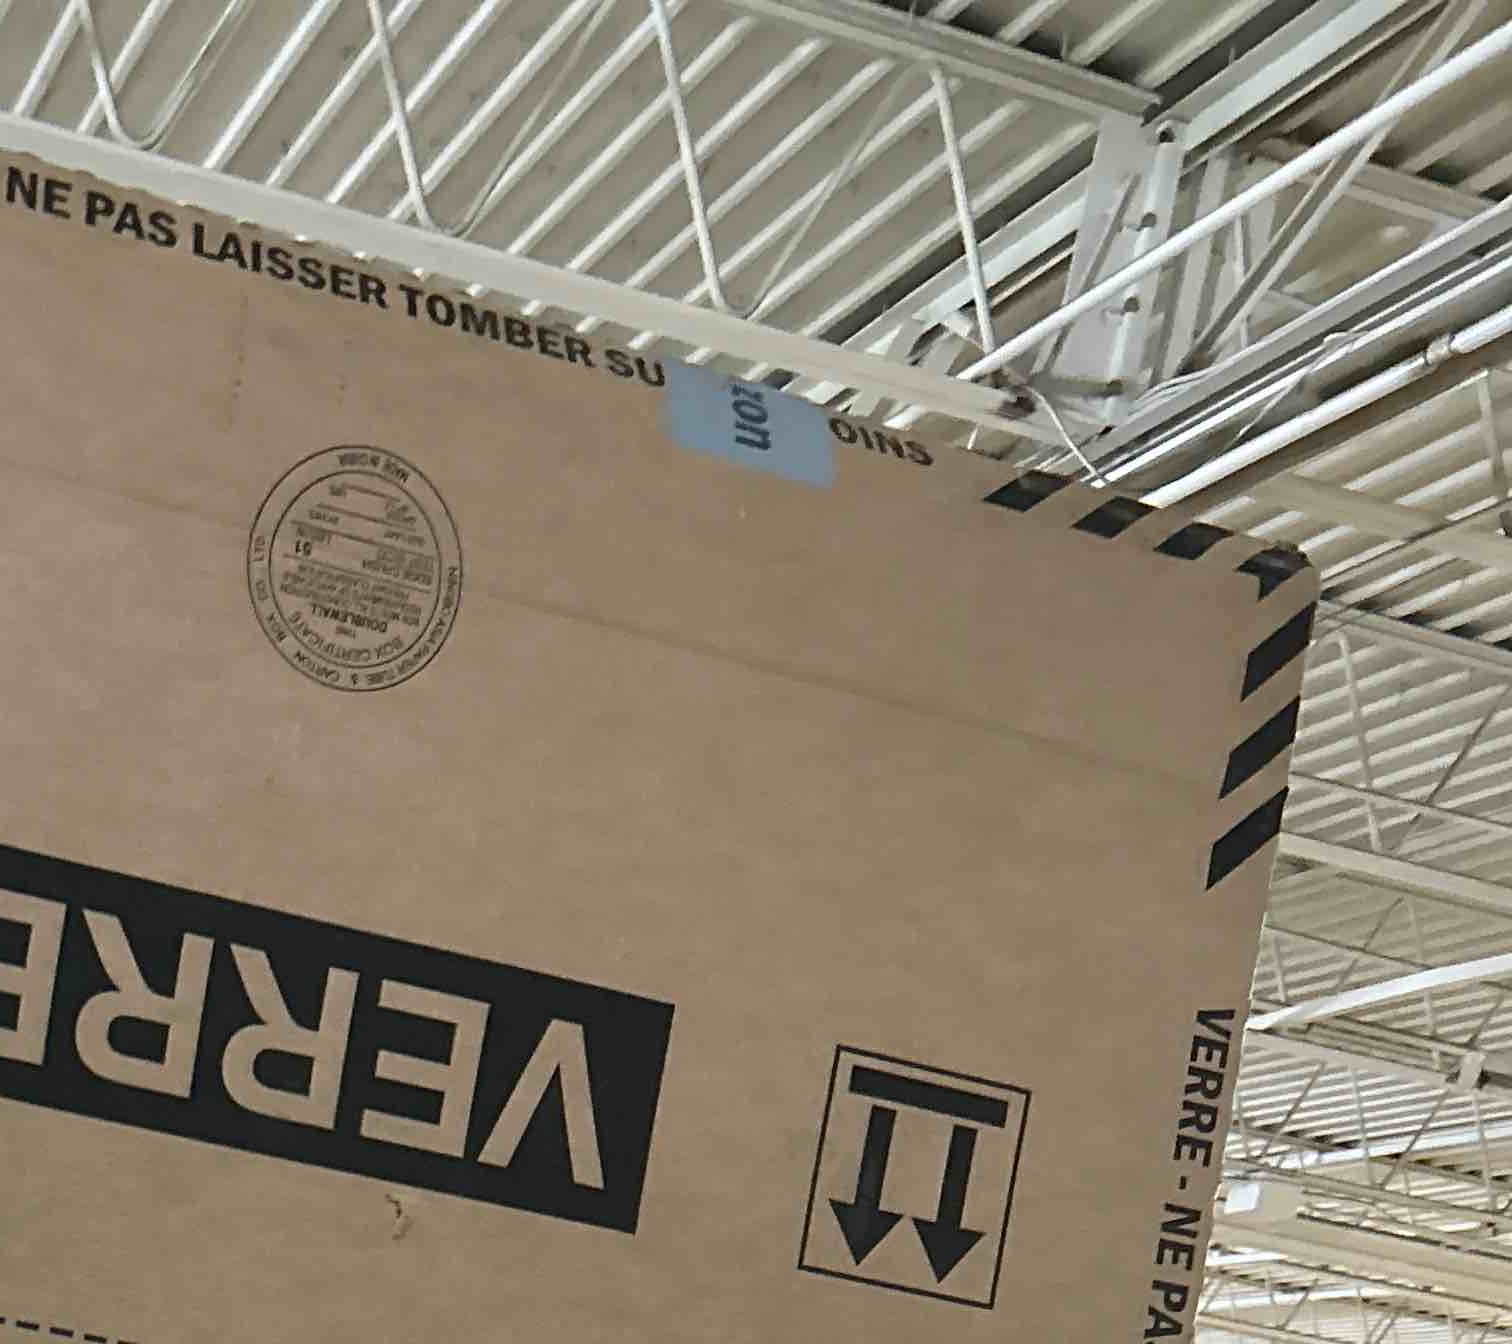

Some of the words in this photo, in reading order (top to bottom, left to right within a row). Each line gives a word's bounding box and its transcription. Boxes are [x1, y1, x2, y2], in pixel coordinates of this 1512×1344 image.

[5, 166, 72, 219] NE
[85, 189, 179, 249] PAS
[193, 222, 389, 309] LAISSER
[399, 283, 595, 369] TOMBER
[606, 347, 667, 388] SU
[828, 415, 935, 467] OINS
[1173, 1008, 1236, 1168] VERRE
[1154, 1202, 1202, 1272] NE
